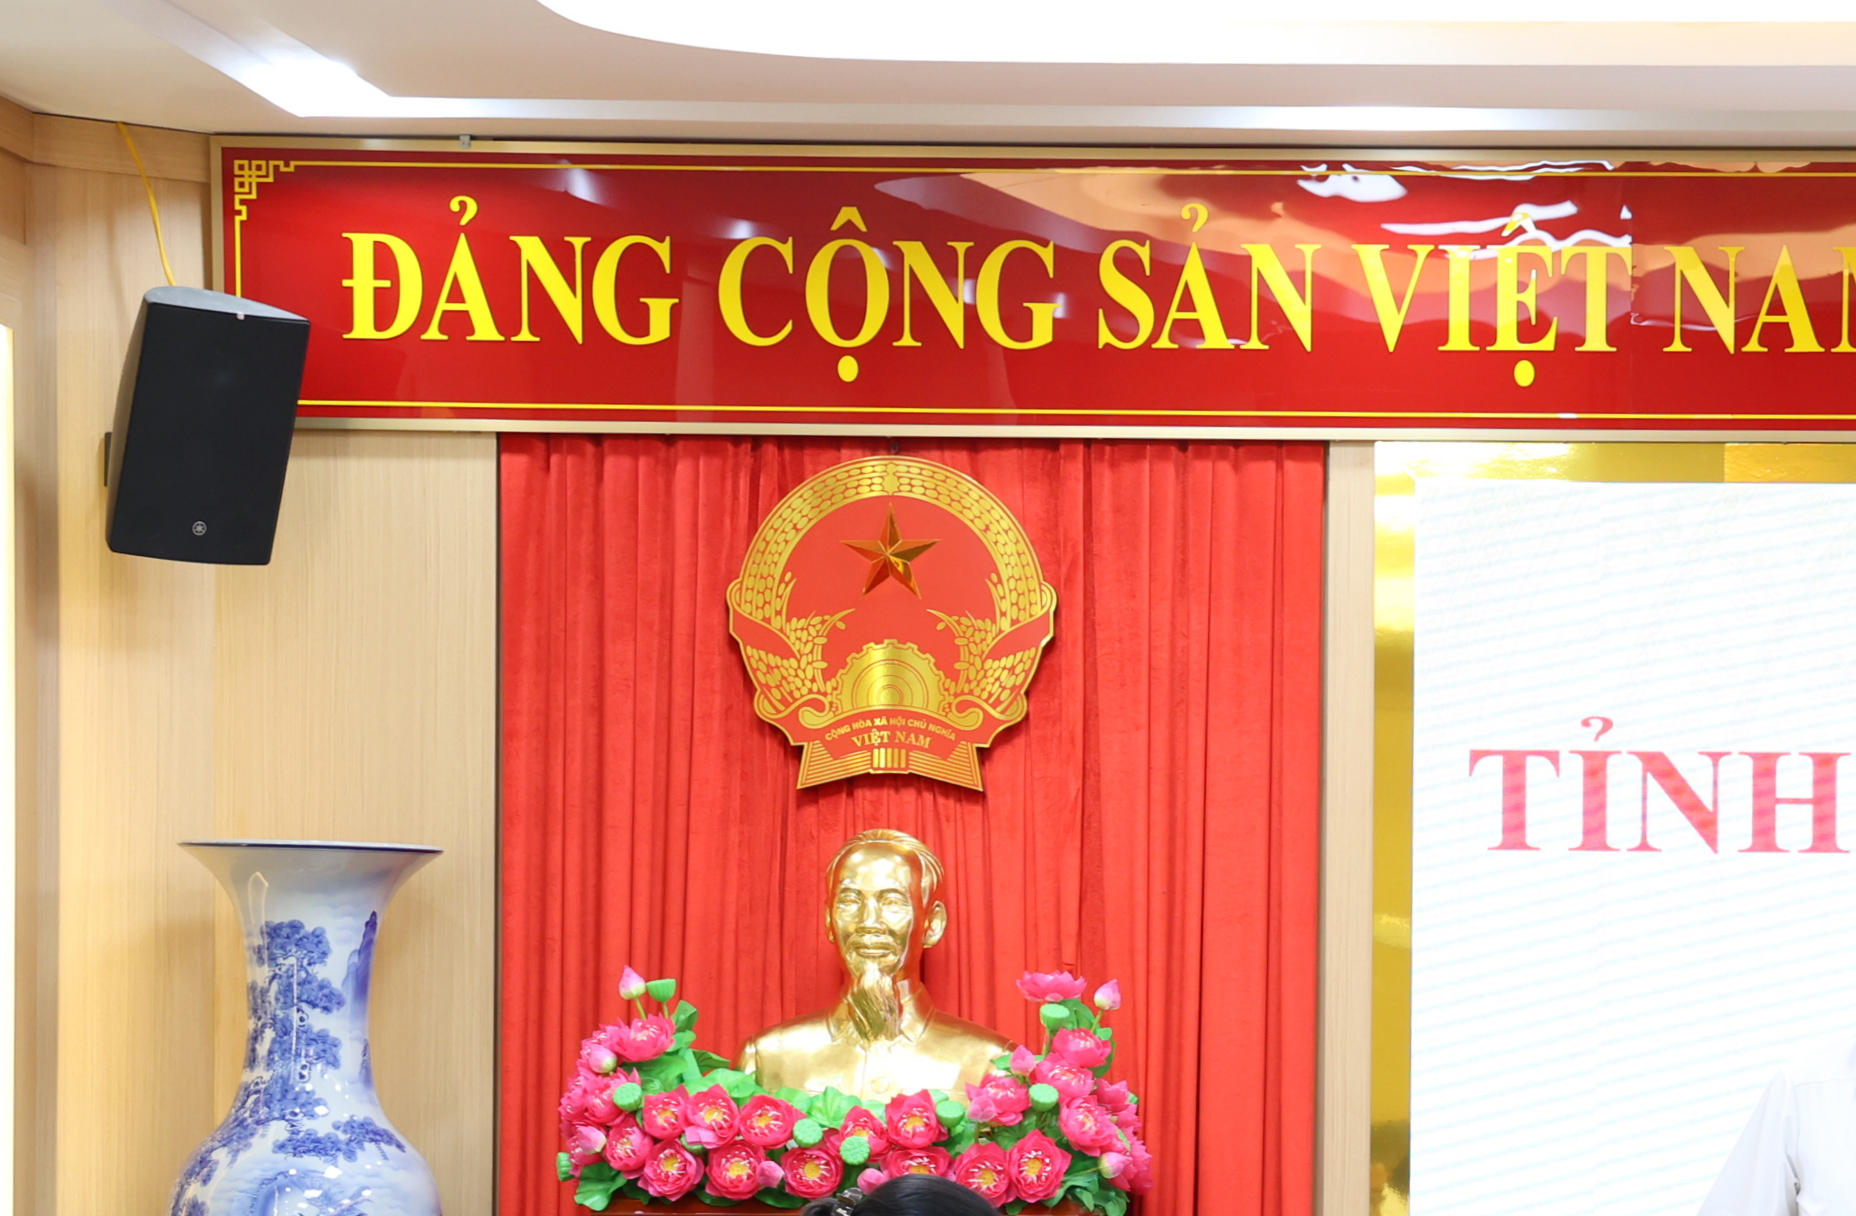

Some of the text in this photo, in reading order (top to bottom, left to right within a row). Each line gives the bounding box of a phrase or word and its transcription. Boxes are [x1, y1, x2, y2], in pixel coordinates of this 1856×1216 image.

[342, 195, 679, 346] ĐẢNG
[718, 205, 1060, 383] CỘNG
[1097, 203, 1313, 351] SẢN
[1352, 213, 1635, 388] VIỆT
[824, 716, 956, 741] CỘNG HÒA XÃ HỘI CHỦ NGHĨA
[851, 728, 933, 749] VIỆT NAM
[1468, 715, 1851, 855] TỈNH
